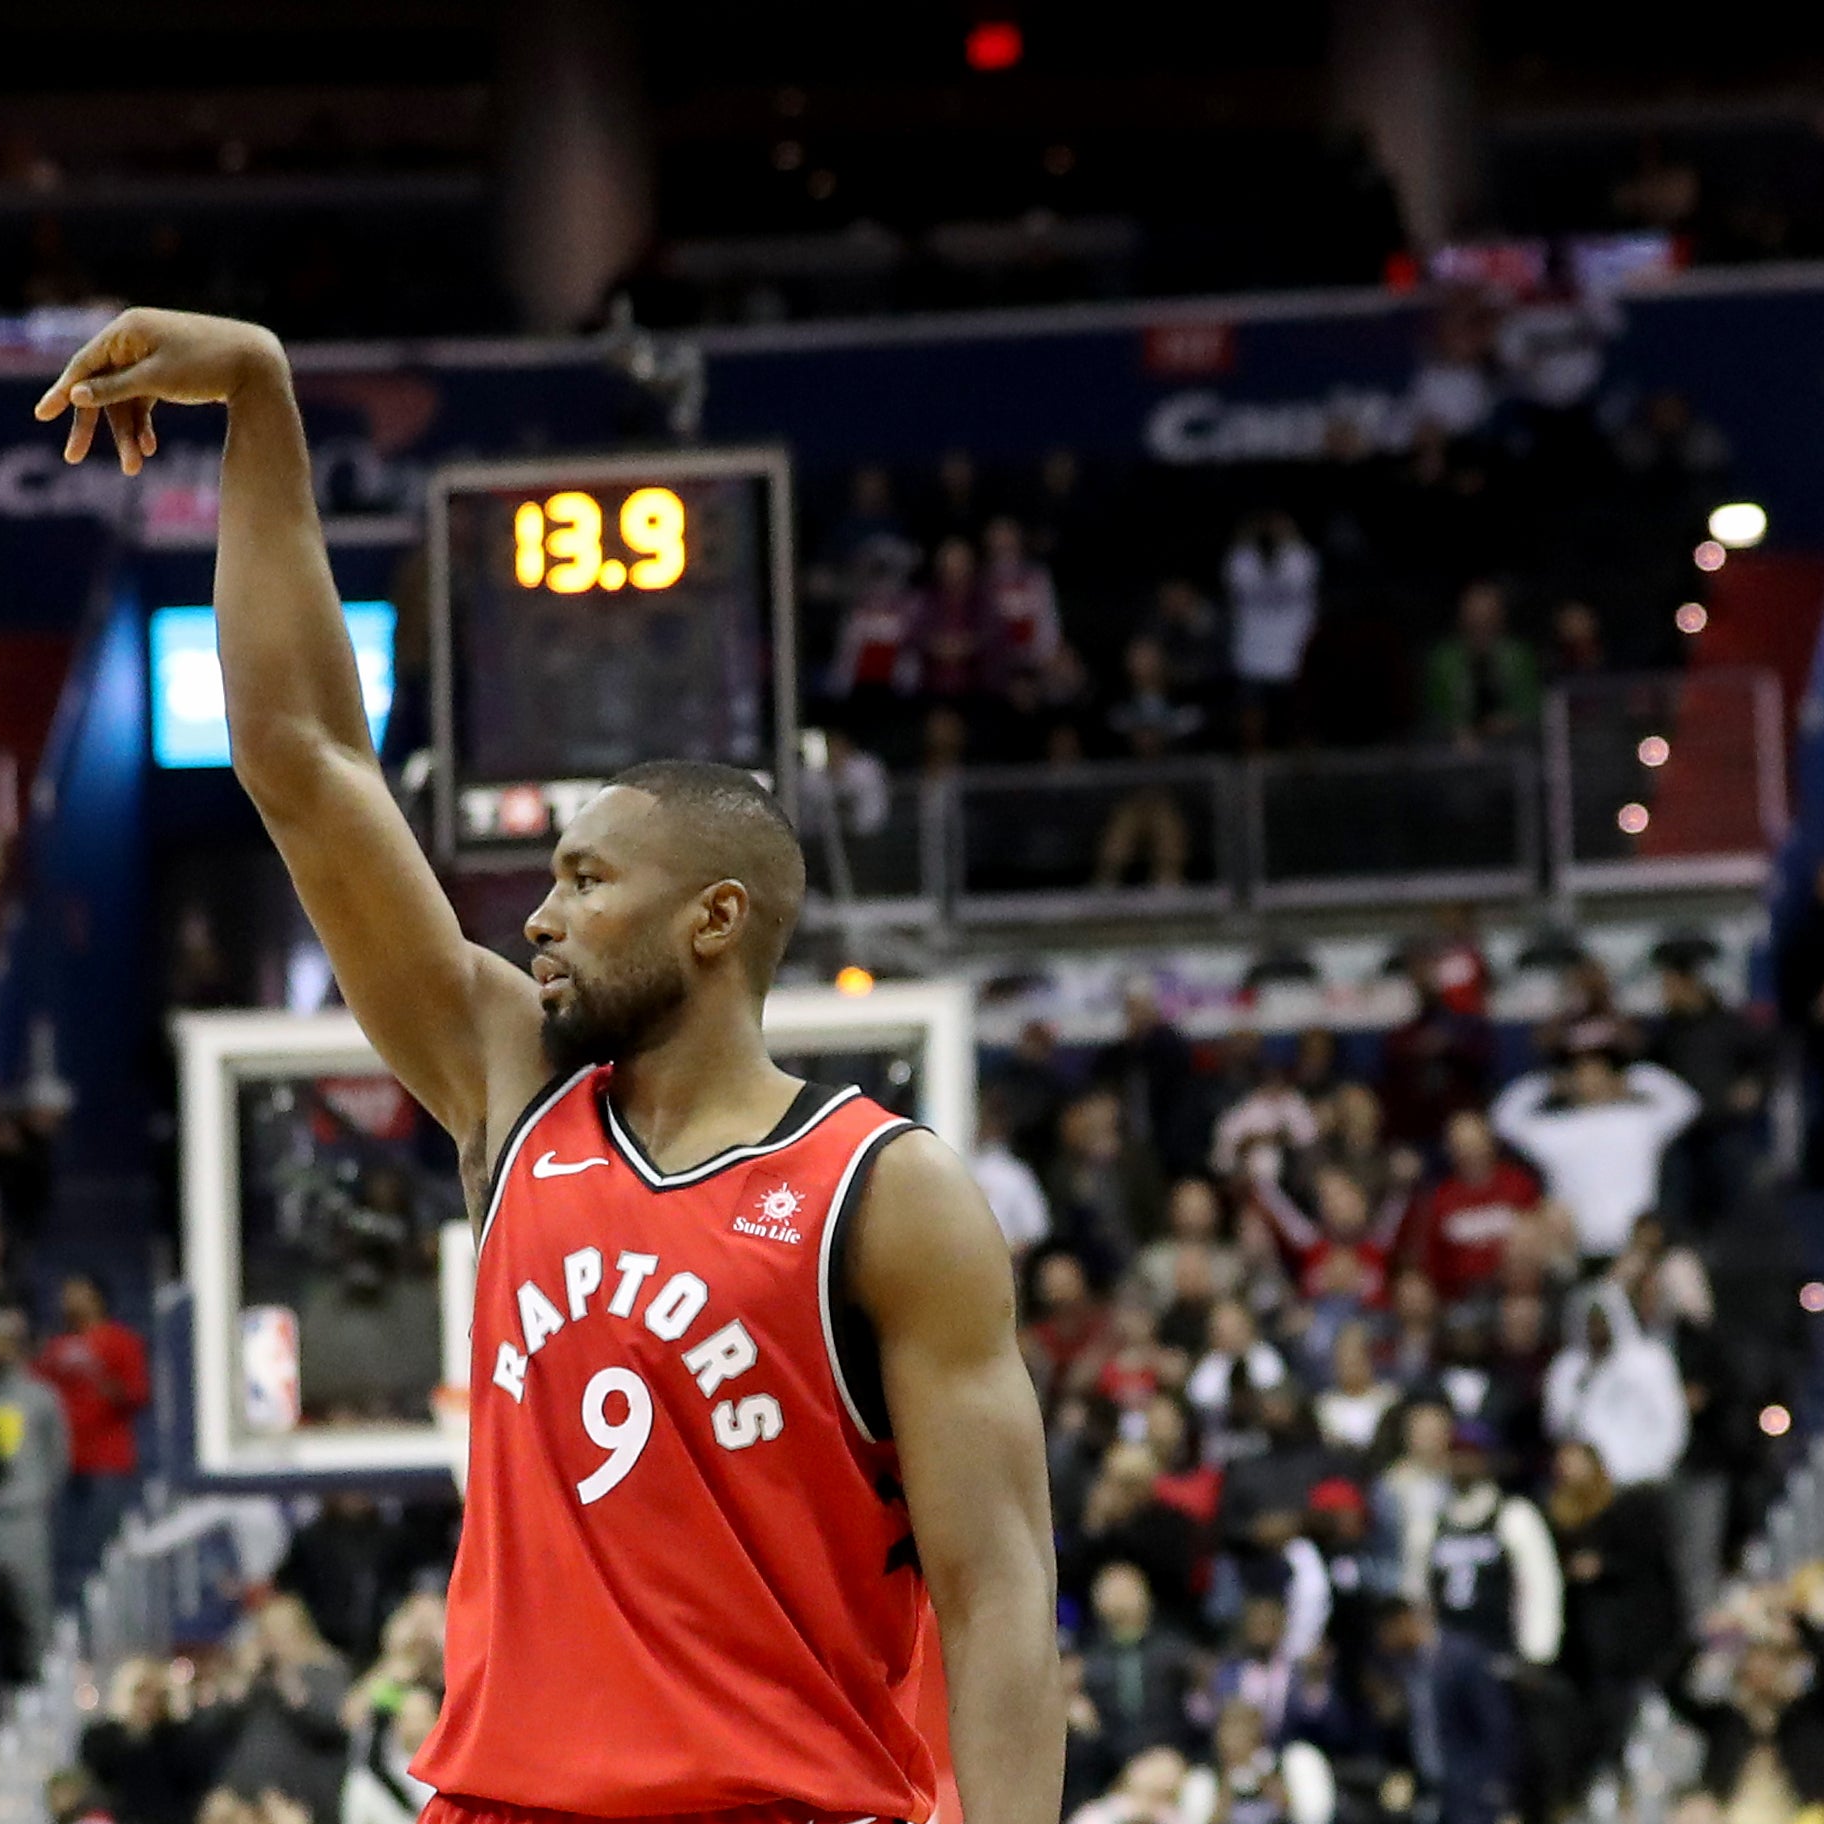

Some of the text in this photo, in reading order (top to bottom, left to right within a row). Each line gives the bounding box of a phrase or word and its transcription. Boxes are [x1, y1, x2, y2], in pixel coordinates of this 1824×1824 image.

[514, 486, 686, 594] 13.9
[733, 1216, 802, 1245] Sun Life
[491, 1245, 785, 1452] RAPTORS
[575, 1366, 654, 1506] 9
